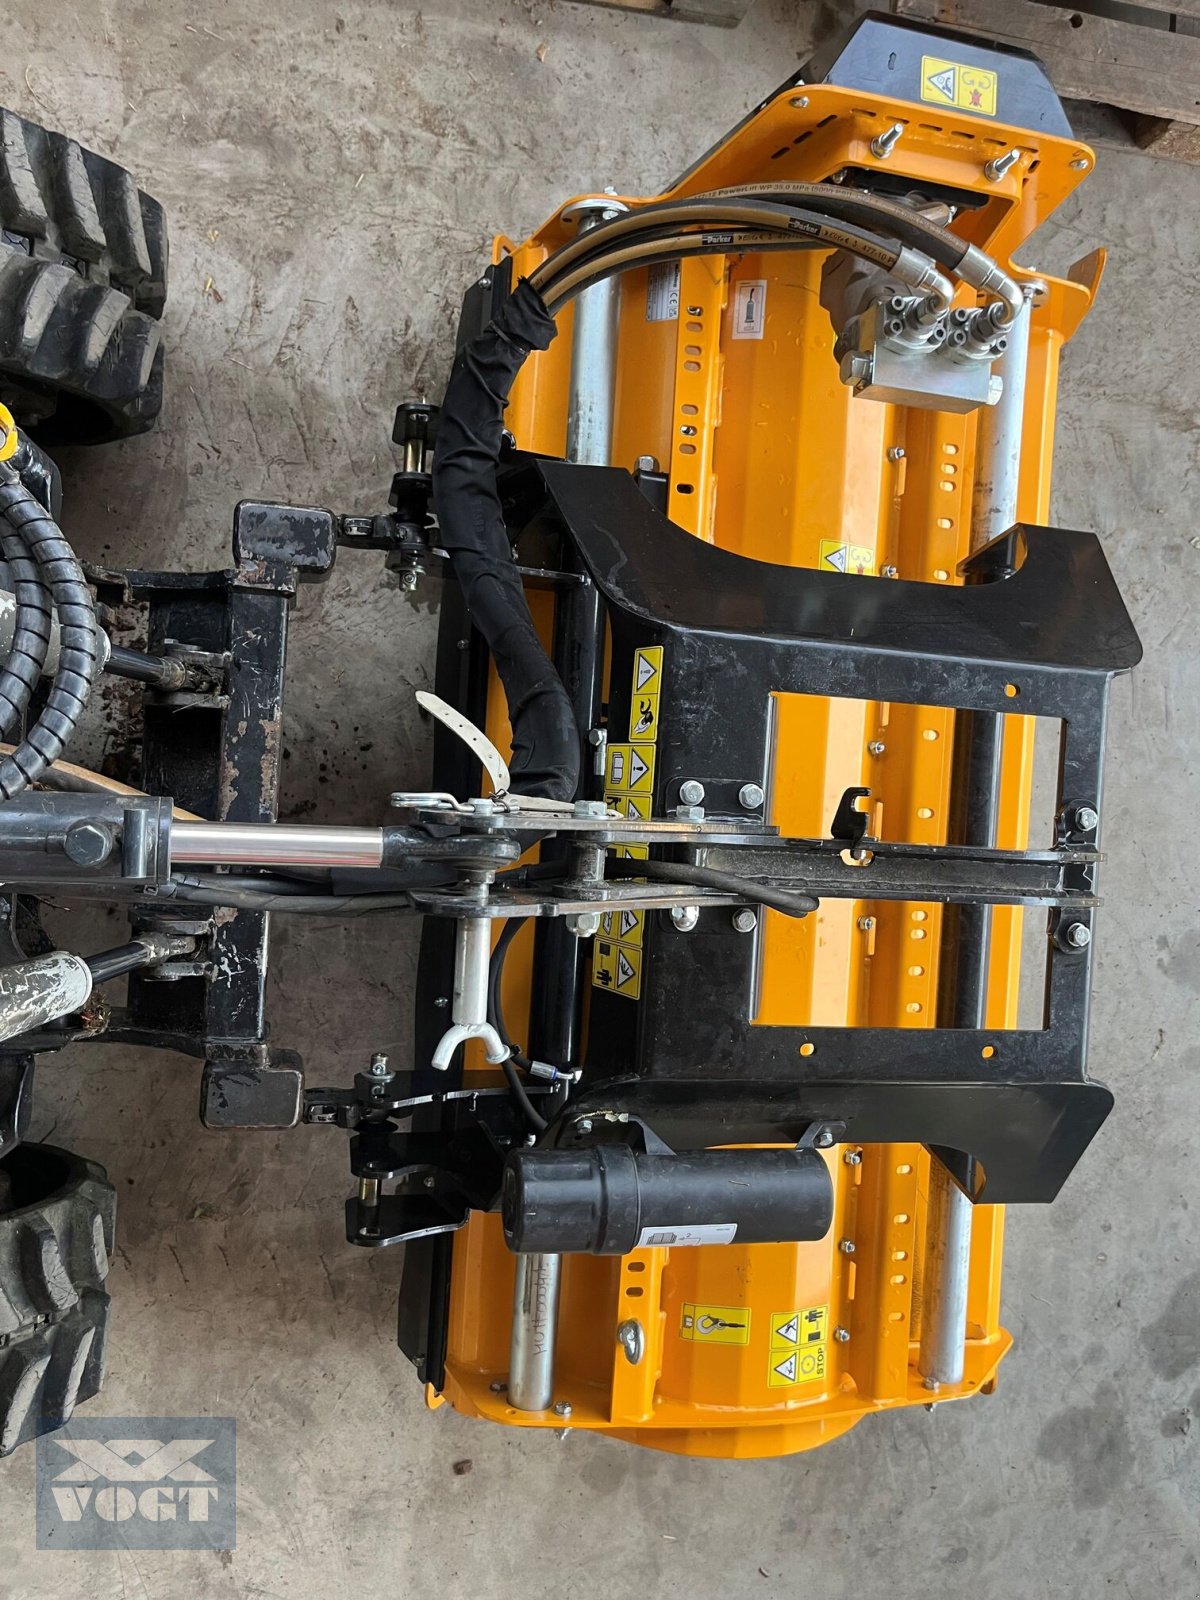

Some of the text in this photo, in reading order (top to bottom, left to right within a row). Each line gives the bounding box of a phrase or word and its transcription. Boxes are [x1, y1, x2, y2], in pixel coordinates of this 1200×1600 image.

[789, 220, 818, 233] Parker
[702, 235, 731, 244] Parker
[817, 1347, 825, 1375] STOP
